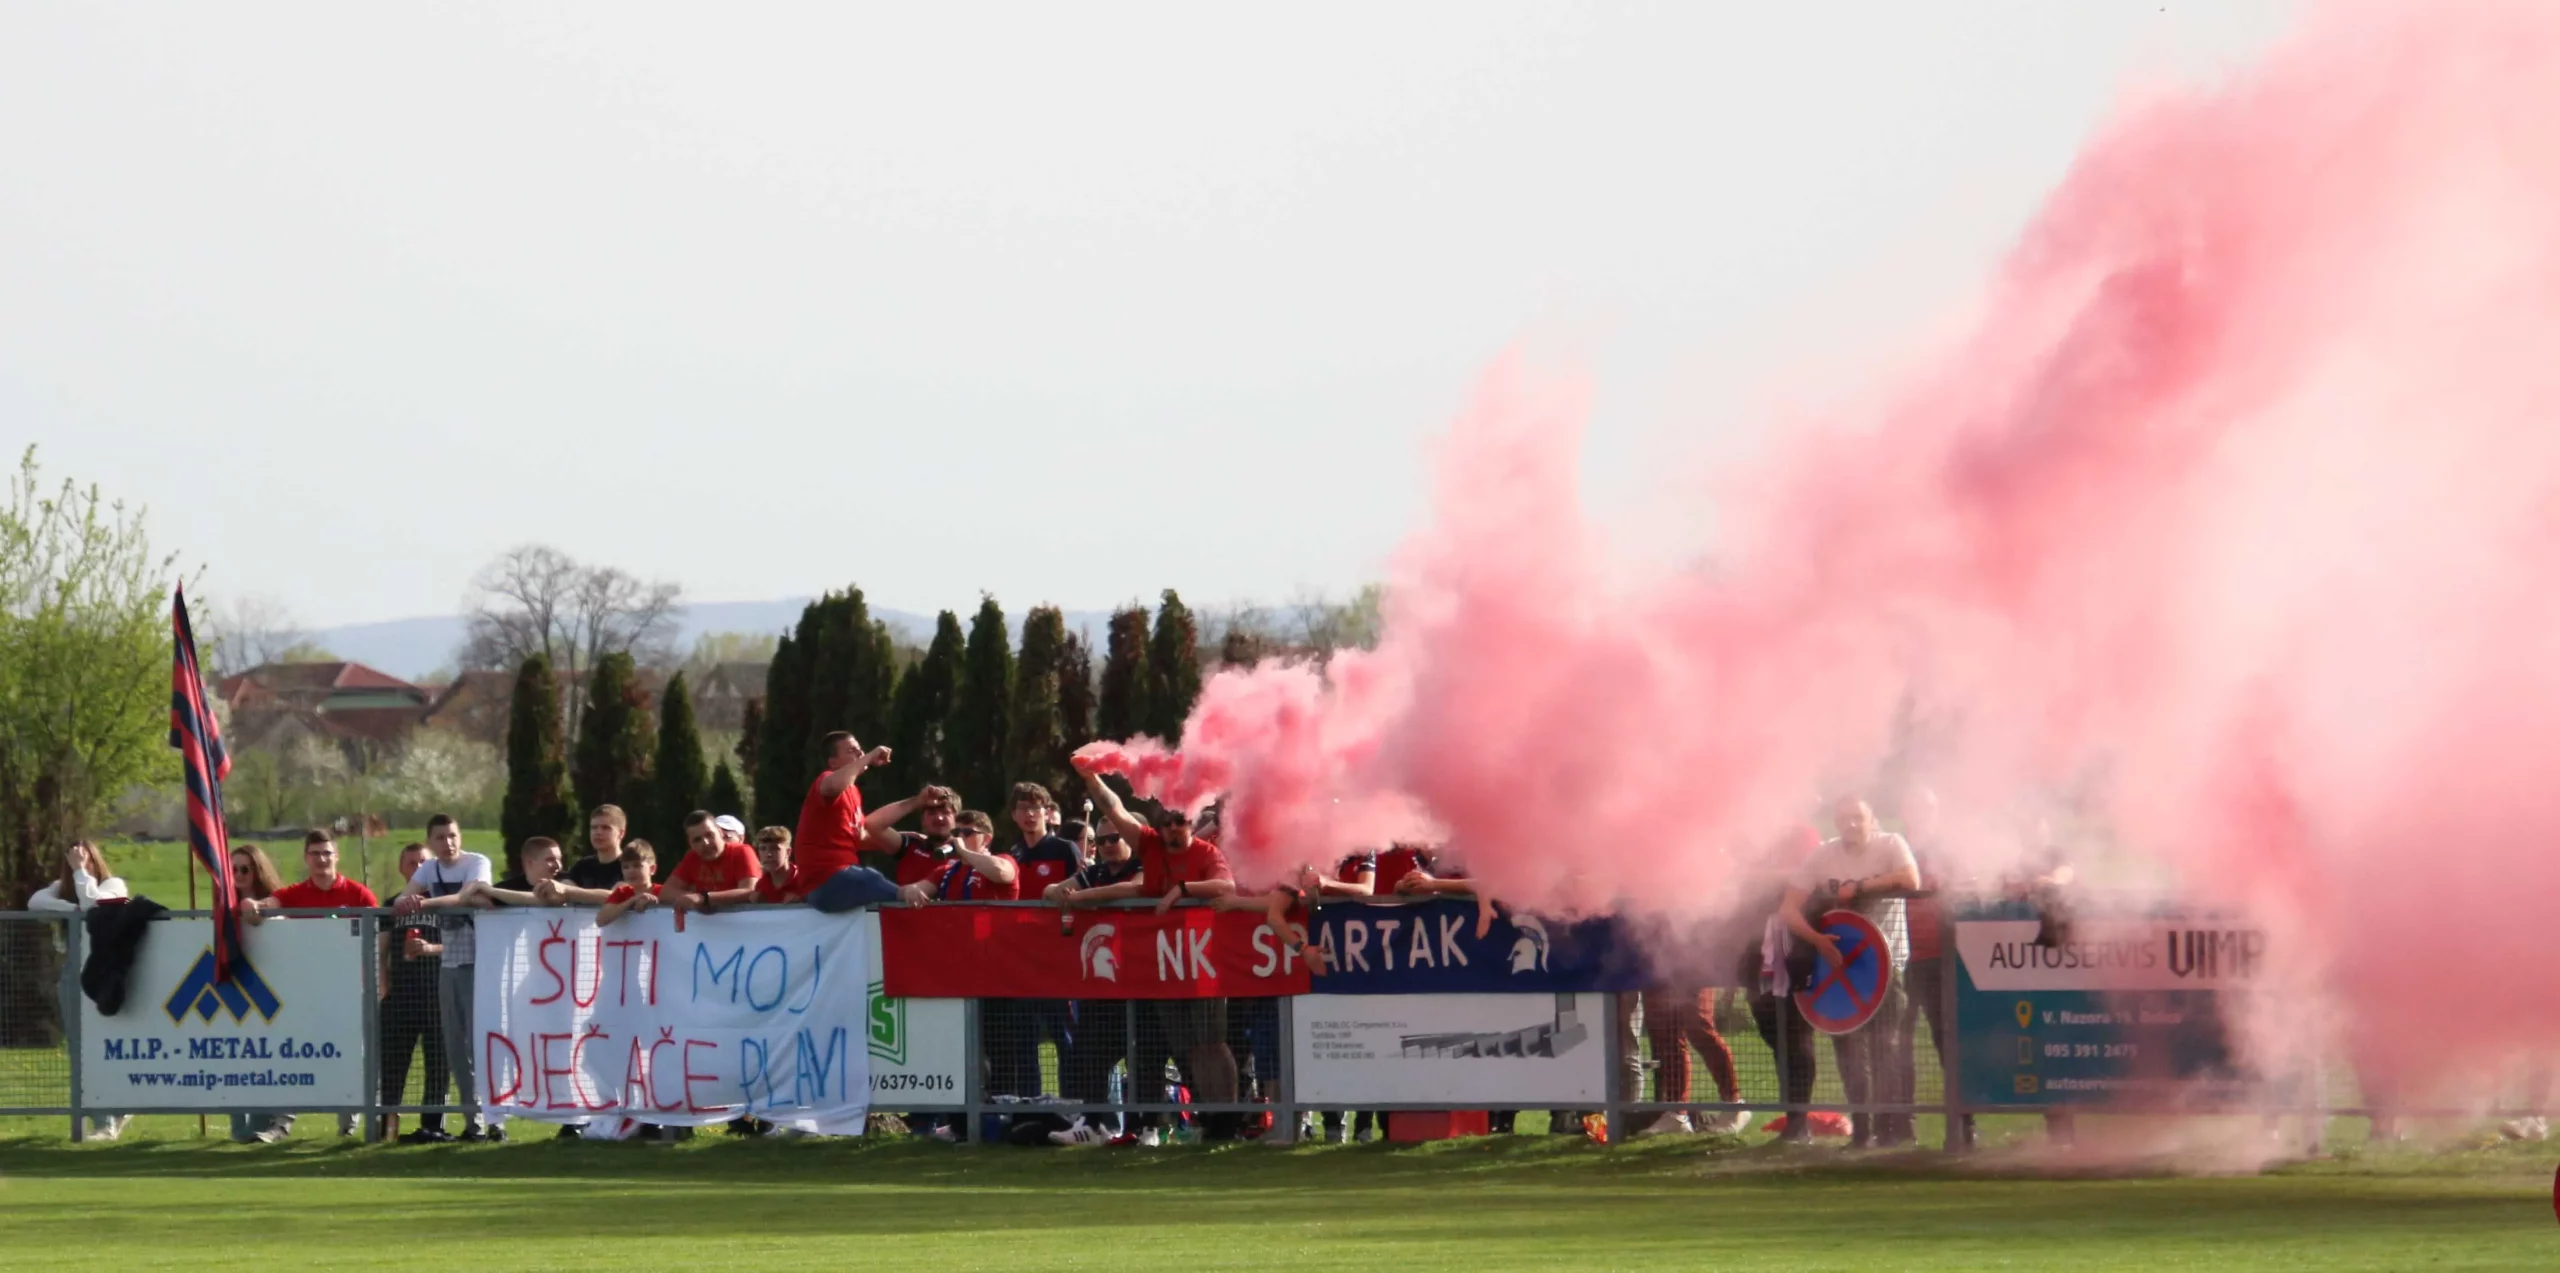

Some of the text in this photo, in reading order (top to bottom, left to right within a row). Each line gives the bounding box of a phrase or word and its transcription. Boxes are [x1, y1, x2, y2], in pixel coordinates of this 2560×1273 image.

[530, 918, 820, 1014] ŠUTI MOJ
[1155, 914, 1469, 981] NK SPARTAK
[1988, 940, 2157, 969] AUTOSERVIS
[103, 1037, 168, 1061] M.I.P.
[188, 1037, 273, 1060] METAL
[279, 1037, 342, 1059] d.o.o.
[486, 1024, 847, 1114] DJEČAČE PLAVI
[128, 1069, 315, 1091] www.mip-metal.com
